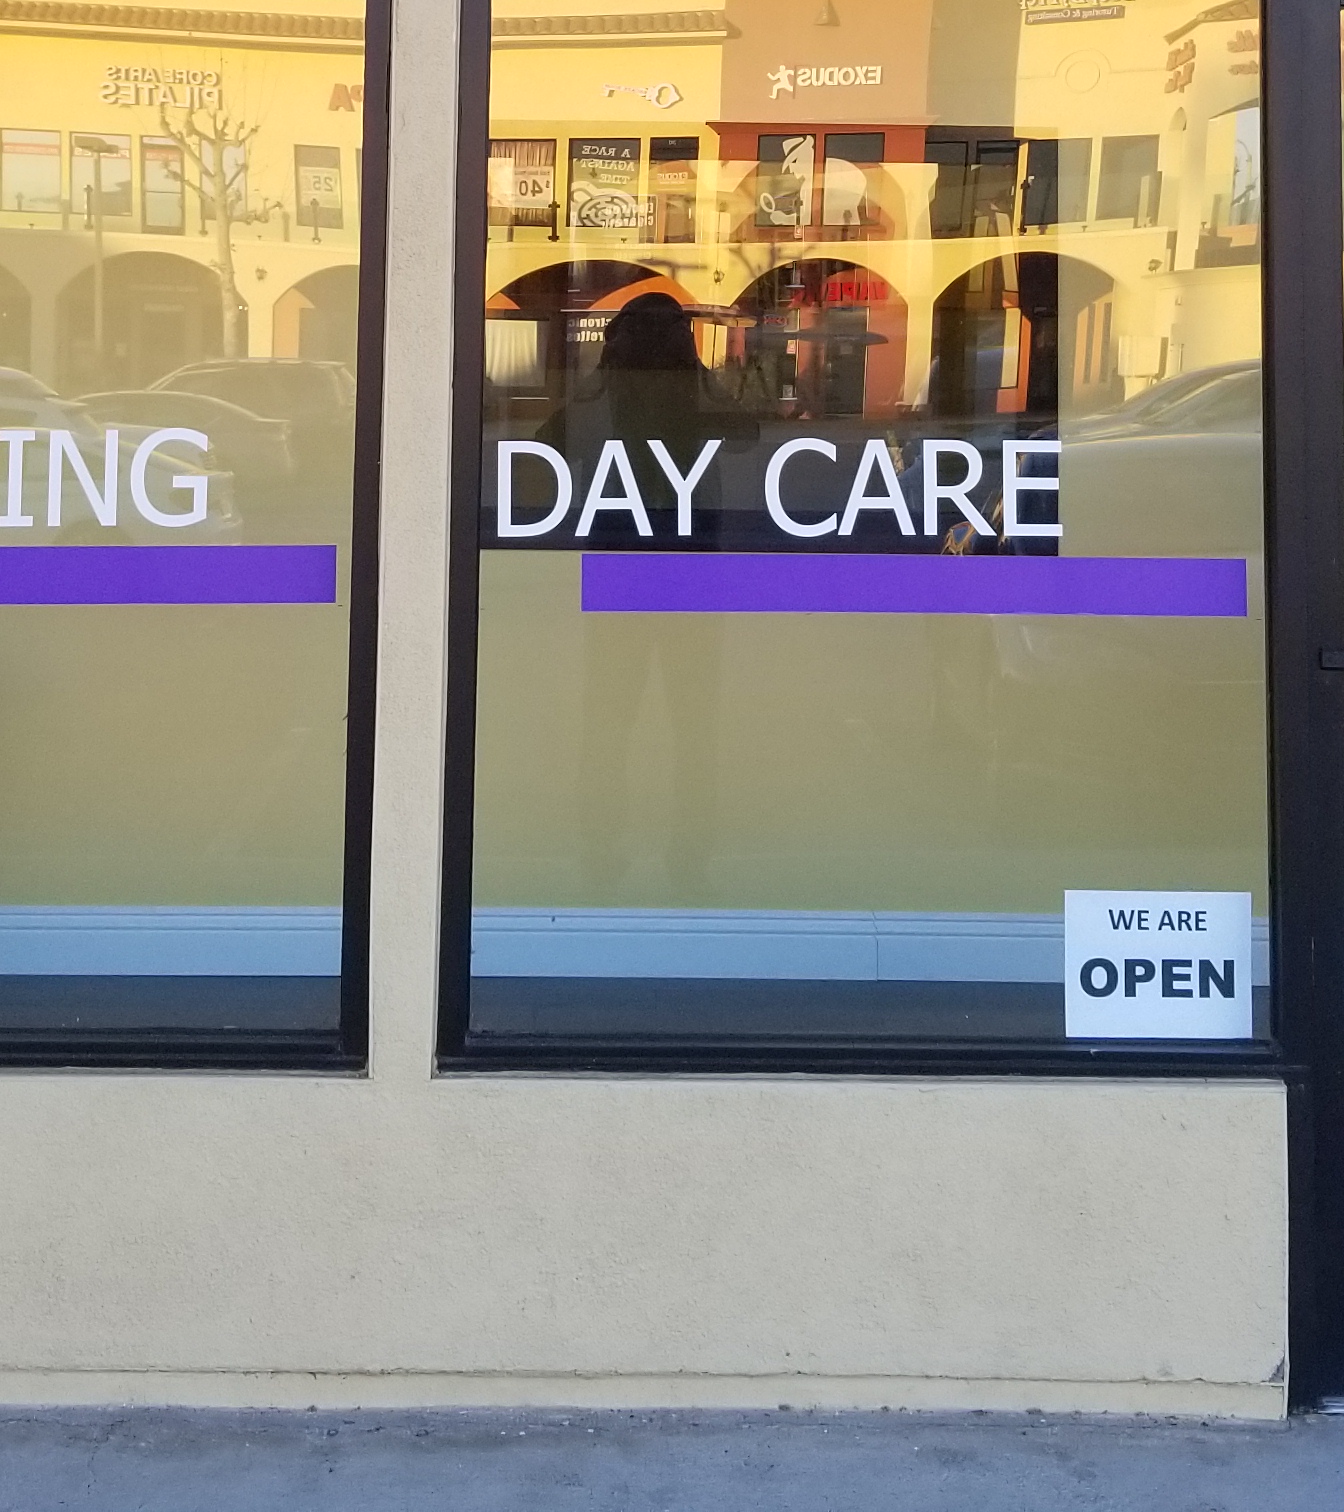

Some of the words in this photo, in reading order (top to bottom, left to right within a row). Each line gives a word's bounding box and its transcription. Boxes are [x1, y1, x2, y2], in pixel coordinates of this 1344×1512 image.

[496, 438, 722, 539] DAY
[764, 437, 1064, 539] CARE
[1108, 909, 1151, 931] WE
[1157, 910, 1208, 932] ARE
[1079, 957, 1236, 999] OPEN
